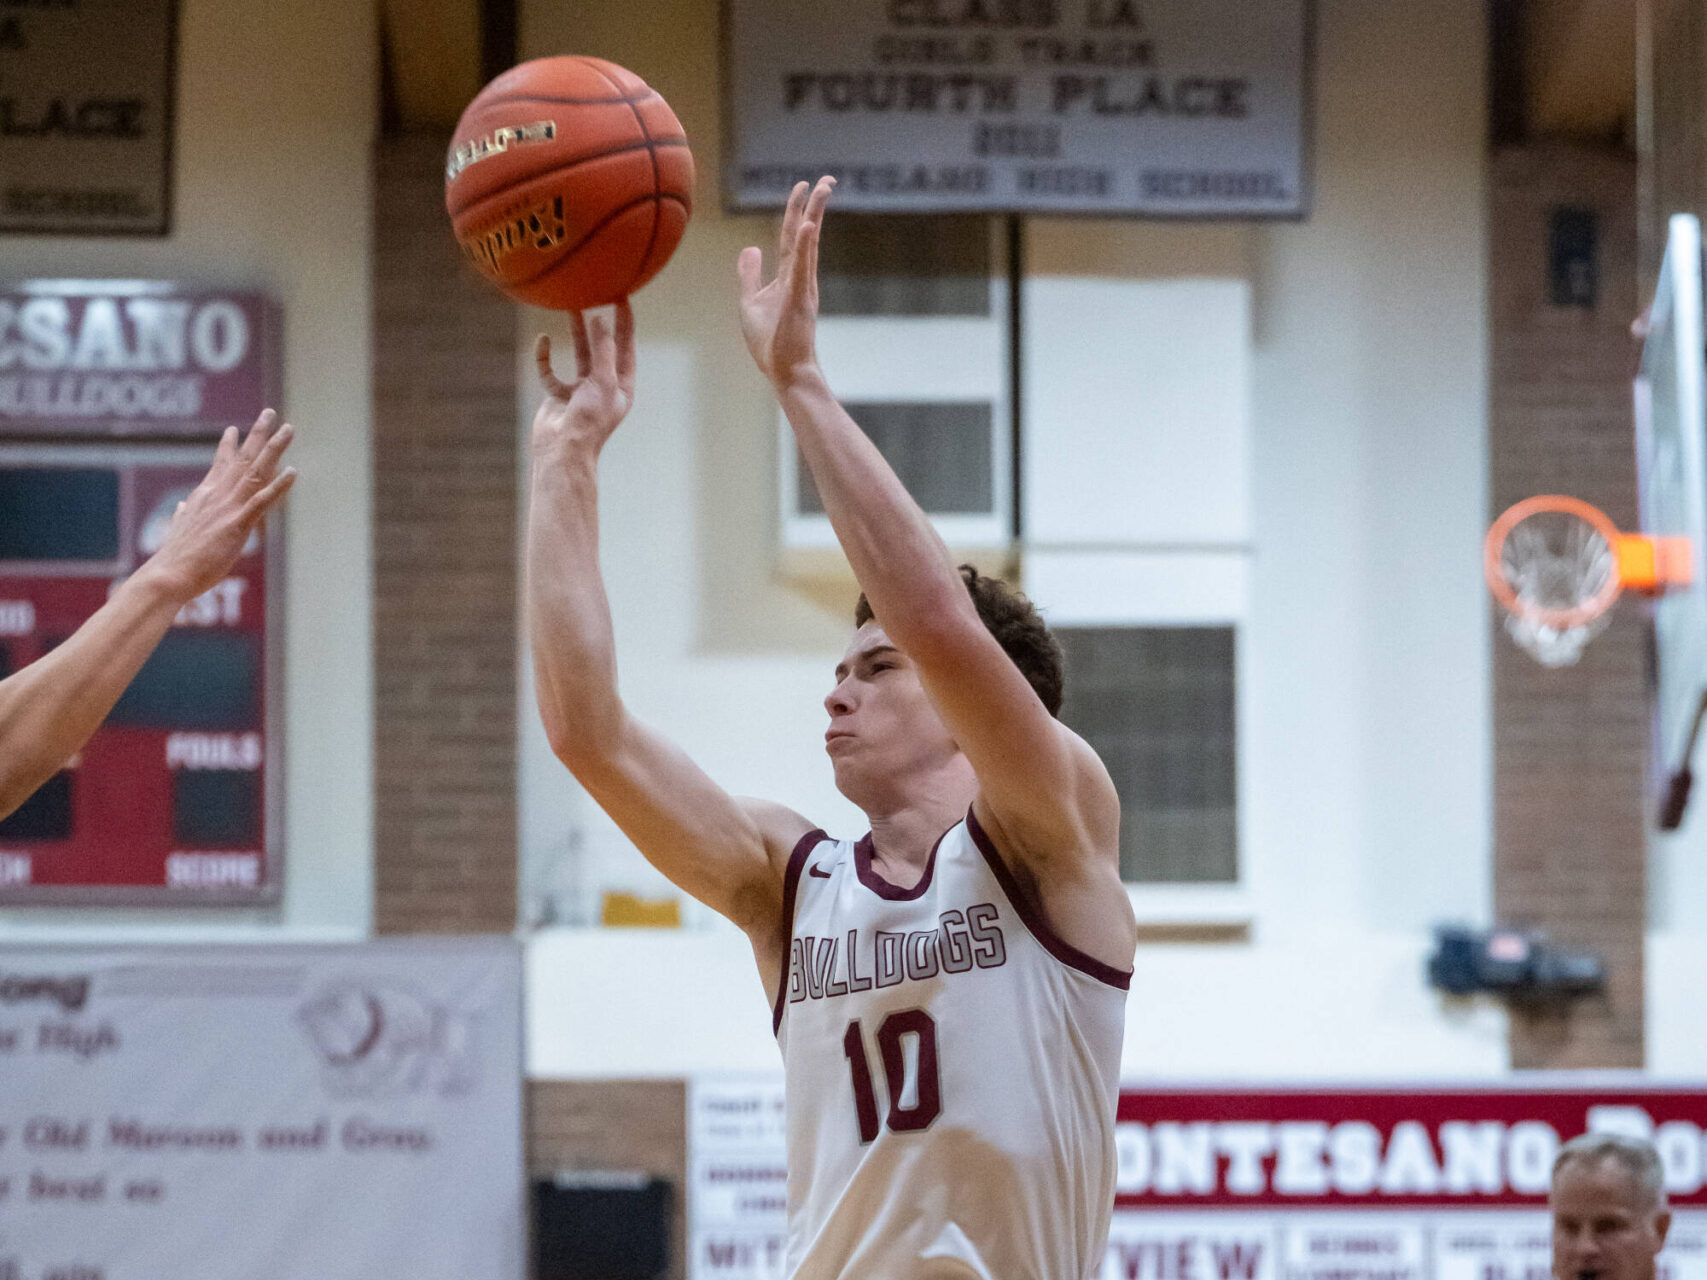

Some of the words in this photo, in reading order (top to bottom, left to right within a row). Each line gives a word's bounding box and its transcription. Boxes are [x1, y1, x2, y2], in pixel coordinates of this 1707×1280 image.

[782, 73, 1016, 112] FOURTH
[1052, 77, 1251, 118] PLACE
[788, 902, 1008, 1004] BULLDOGS
[842, 1005, 945, 1148] 10
